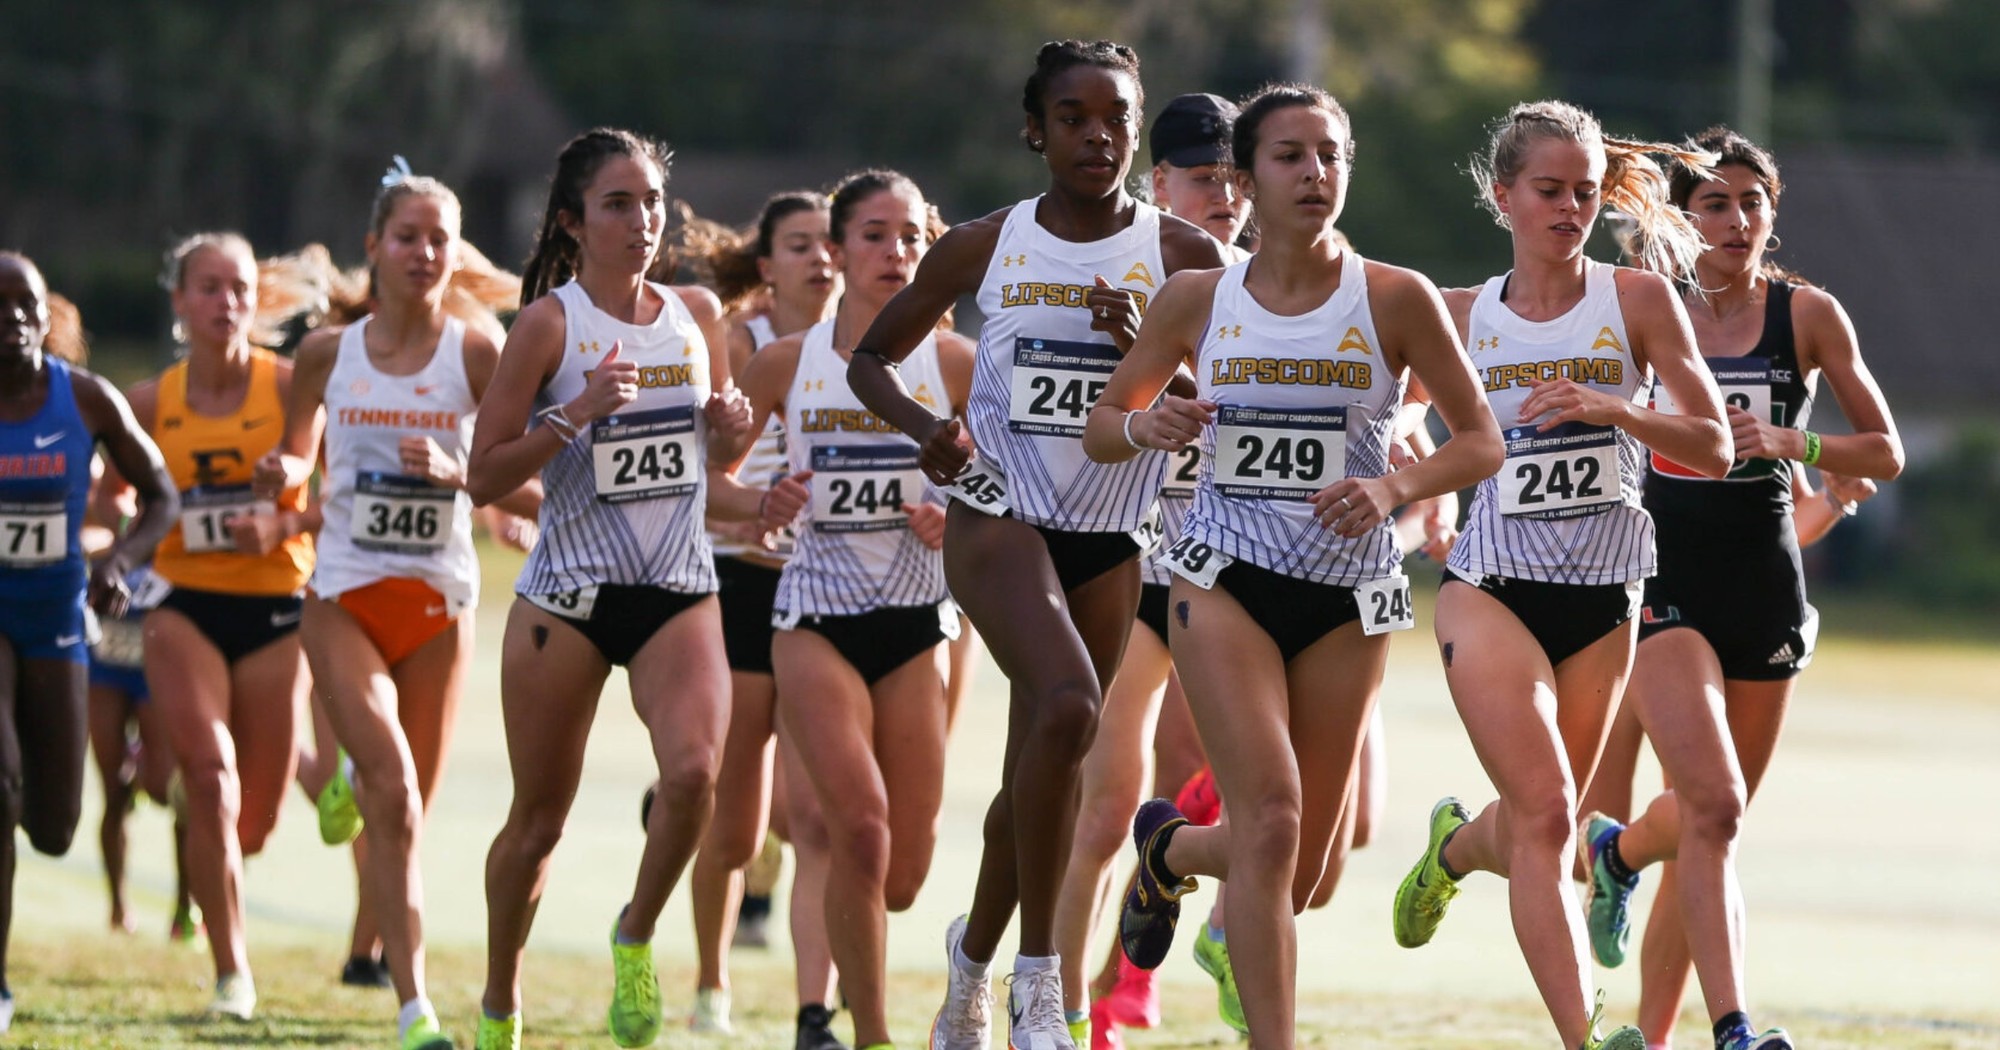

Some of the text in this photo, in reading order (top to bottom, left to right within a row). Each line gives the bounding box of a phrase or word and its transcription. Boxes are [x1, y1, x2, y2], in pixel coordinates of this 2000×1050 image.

[1001, 283, 1149, 319] LIPSCOB
[1031, 353, 1052, 362] CROSS
[1053, 355, 1081, 365] COUNTRY
[1211, 358, 1373, 391] LIPSCOMB
[1717, 371, 1767, 379] CHAMPIONSHIPS
[1028, 376, 1108, 418] 245
[338, 408, 458, 431] TENNESSEE
[800, 408, 901, 434] LIPSCO
[1236, 411, 1257, 420] CROSS
[1258, 413, 1288, 422] COUNTRY
[1288, 415, 1343, 424] CHAMPIONSHIPS
[1511, 441, 1532, 450] CROSS
[1532, 438, 1562, 448] COUNTRY
[1561, 431, 1613, 445] CHAMPIONSHIPS
[612, 441, 685, 486] 243
[1234, 434, 1325, 482] 249
[829, 478, 905, 516] 244
[953, 462, 1006, 505] 45
[1273, 490, 1305, 498] NOVEMBER
[1515, 456, 1603, 506] 242
[367, 503, 437, 539] 346
[1559, 508, 1588, 517] NOVEMBER
[4, 521, 48, 554] 71
